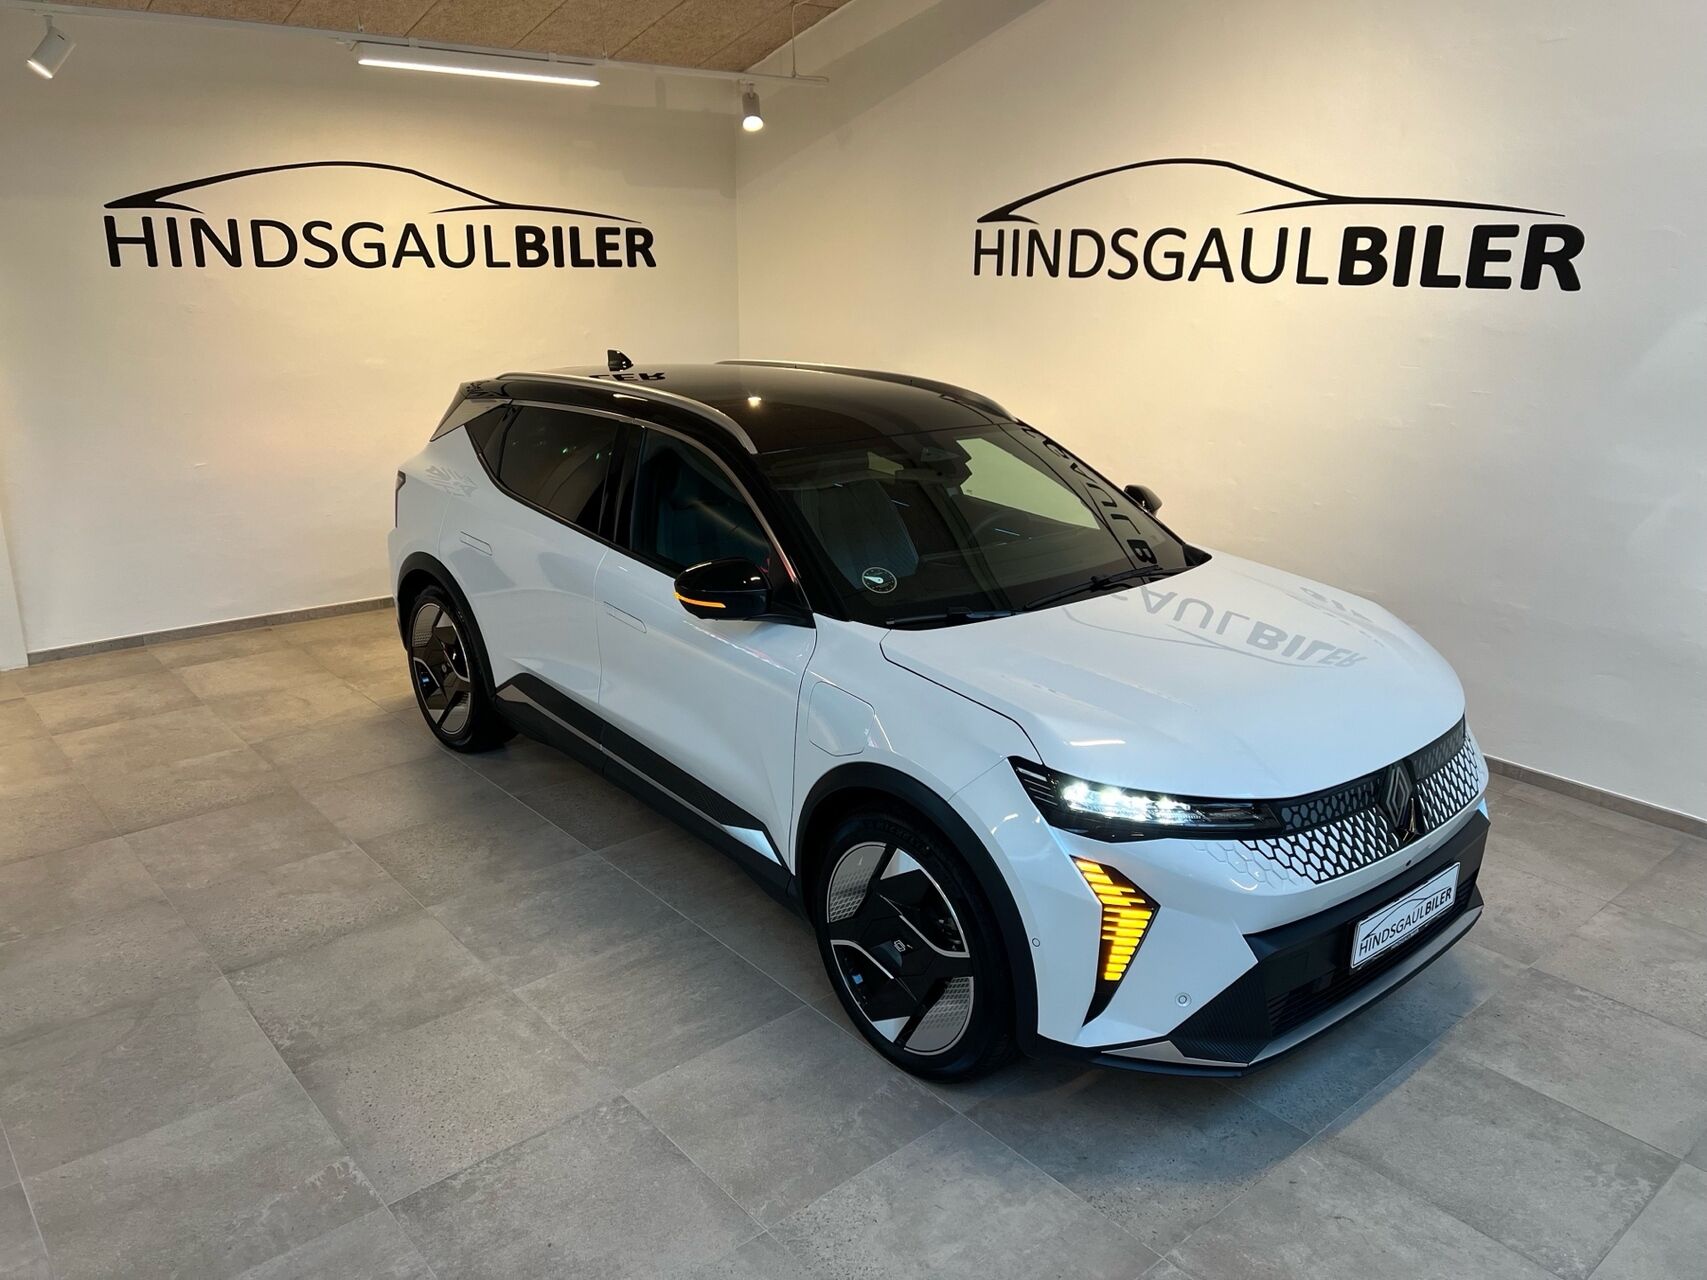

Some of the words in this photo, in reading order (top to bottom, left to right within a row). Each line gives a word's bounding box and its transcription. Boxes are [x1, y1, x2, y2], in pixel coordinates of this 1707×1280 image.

[103, 214, 657, 268] HINDSGAULBILER
[973, 222, 1585, 291] HINDSGAULBILER
[1358, 887, 1452, 957] HINDSGAULBILER
